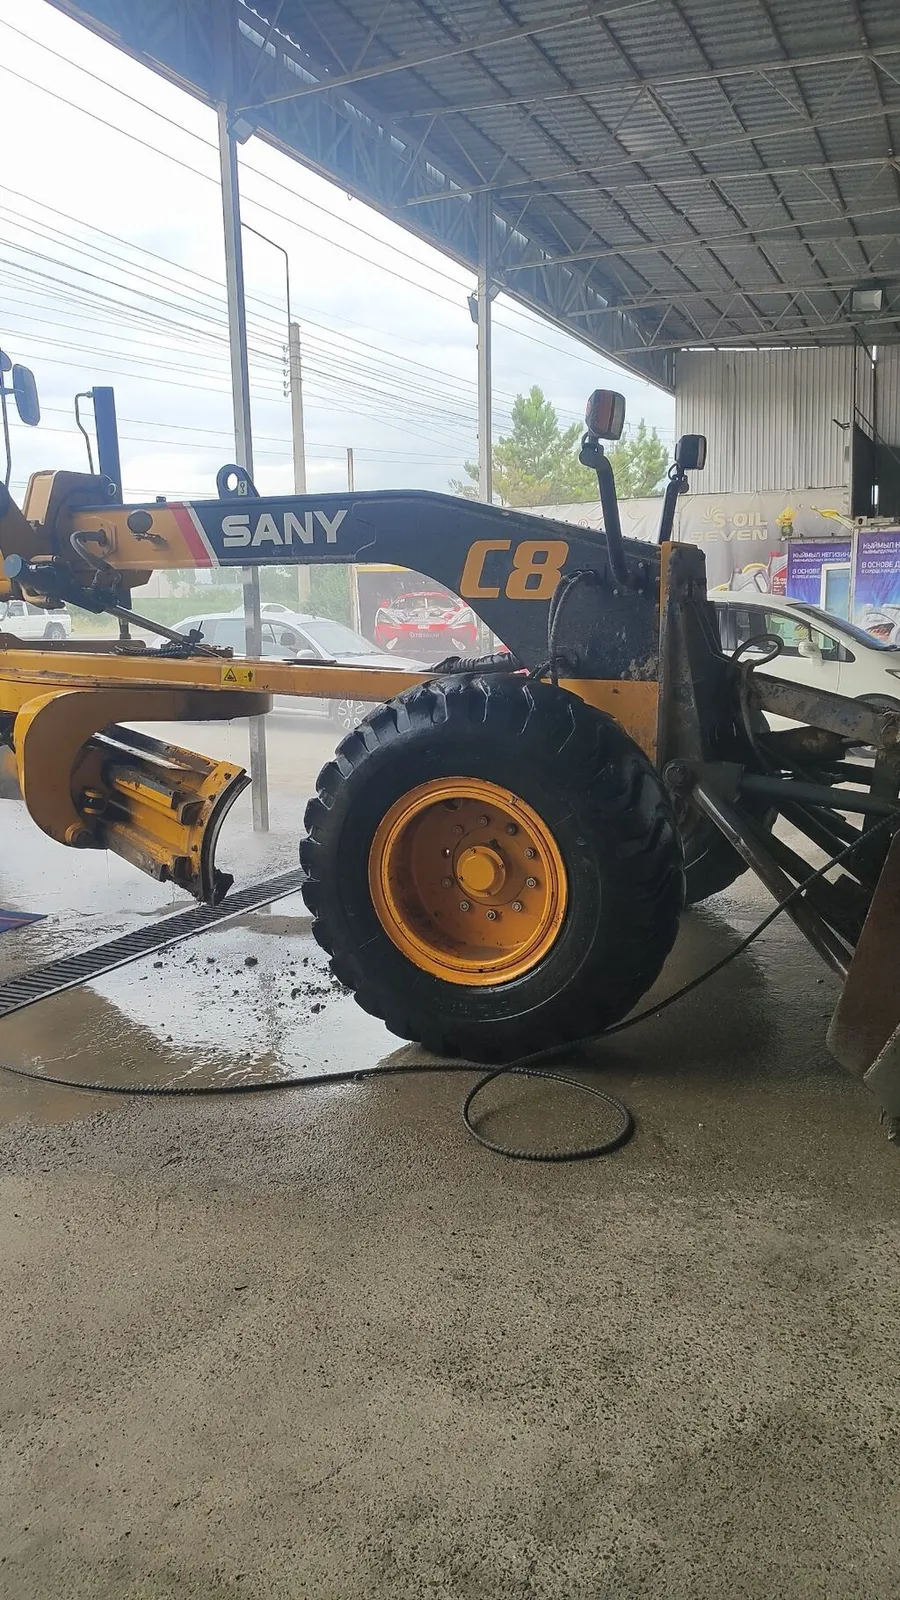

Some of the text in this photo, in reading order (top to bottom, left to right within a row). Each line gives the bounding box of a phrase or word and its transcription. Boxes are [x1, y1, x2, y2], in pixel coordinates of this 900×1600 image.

[222, 509, 347, 547] SANY
[710, 511, 768, 528] S-OIL
[691, 529, 768, 542] SEVEN
[459, 539, 570, 600] C8
[867, 561, 893, 569] ОСНОВЕ
